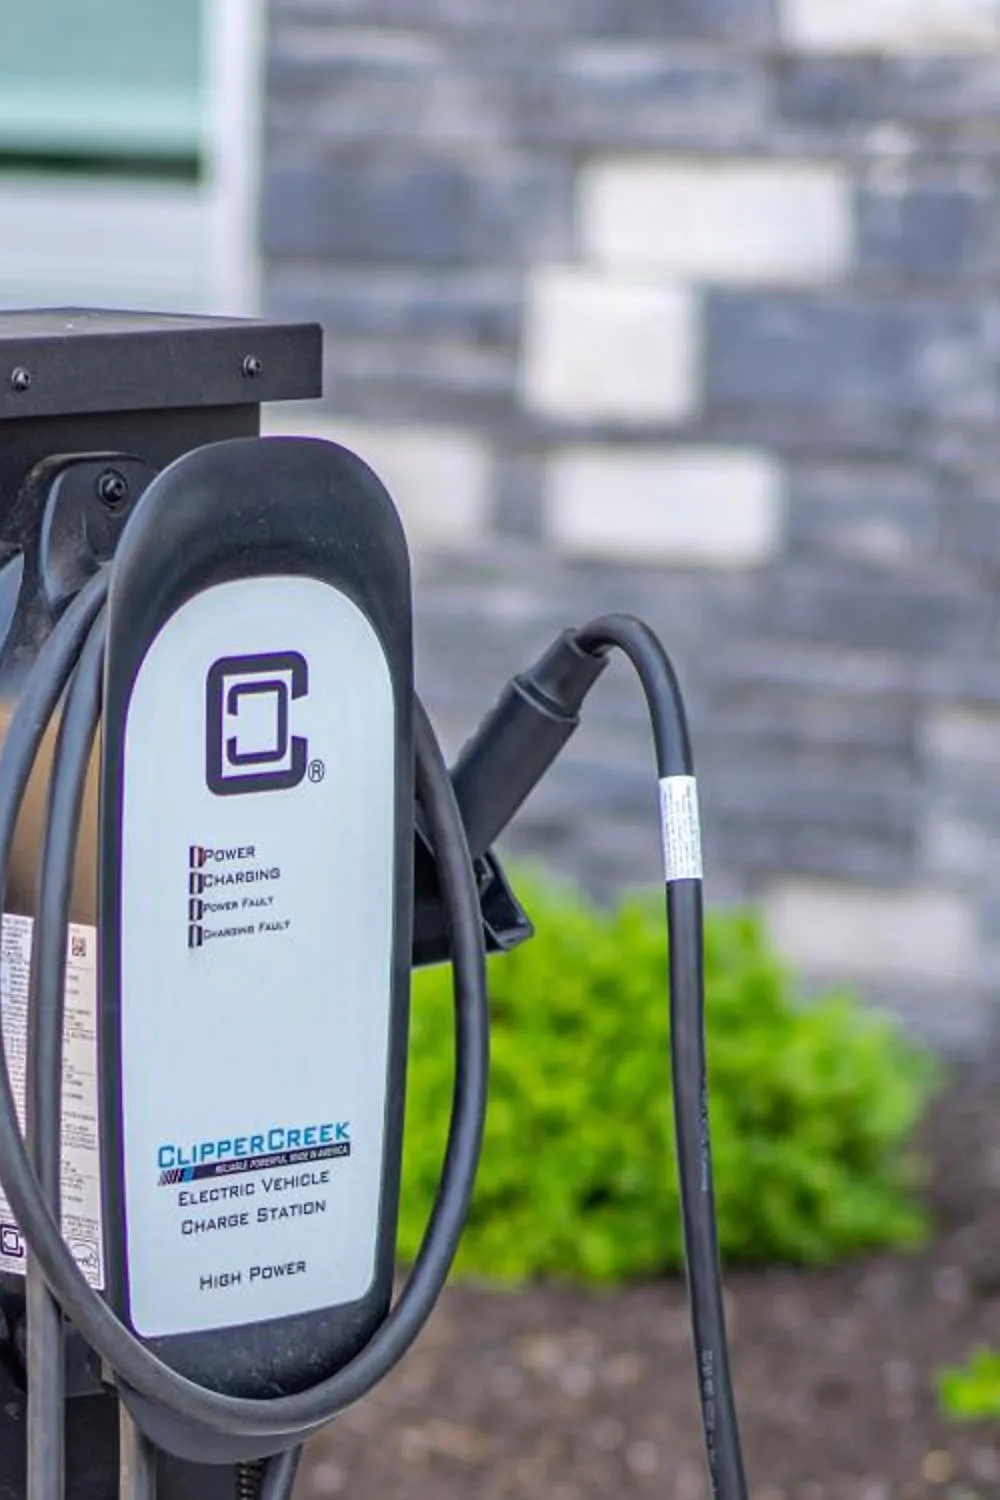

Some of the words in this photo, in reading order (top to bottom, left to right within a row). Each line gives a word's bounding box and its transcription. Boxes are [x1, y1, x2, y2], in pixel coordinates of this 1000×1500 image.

[204, 846, 256, 862] POWER
[204, 867, 281, 888] CHARGING
[204, 900, 238, 914] POWER
[241, 896, 274, 909] FAULT
[259, 920, 291, 933] FAULT
[178, 1183, 255, 1207] ELECTRIC
[262, 1170, 330, 1193] VEHICLE
[181, 1213, 249, 1235] CHARGE
[257, 1200, 326, 1223] STATION
[200, 1272, 241, 1290] HIGH
[250, 1261, 307, 1281] POWER
